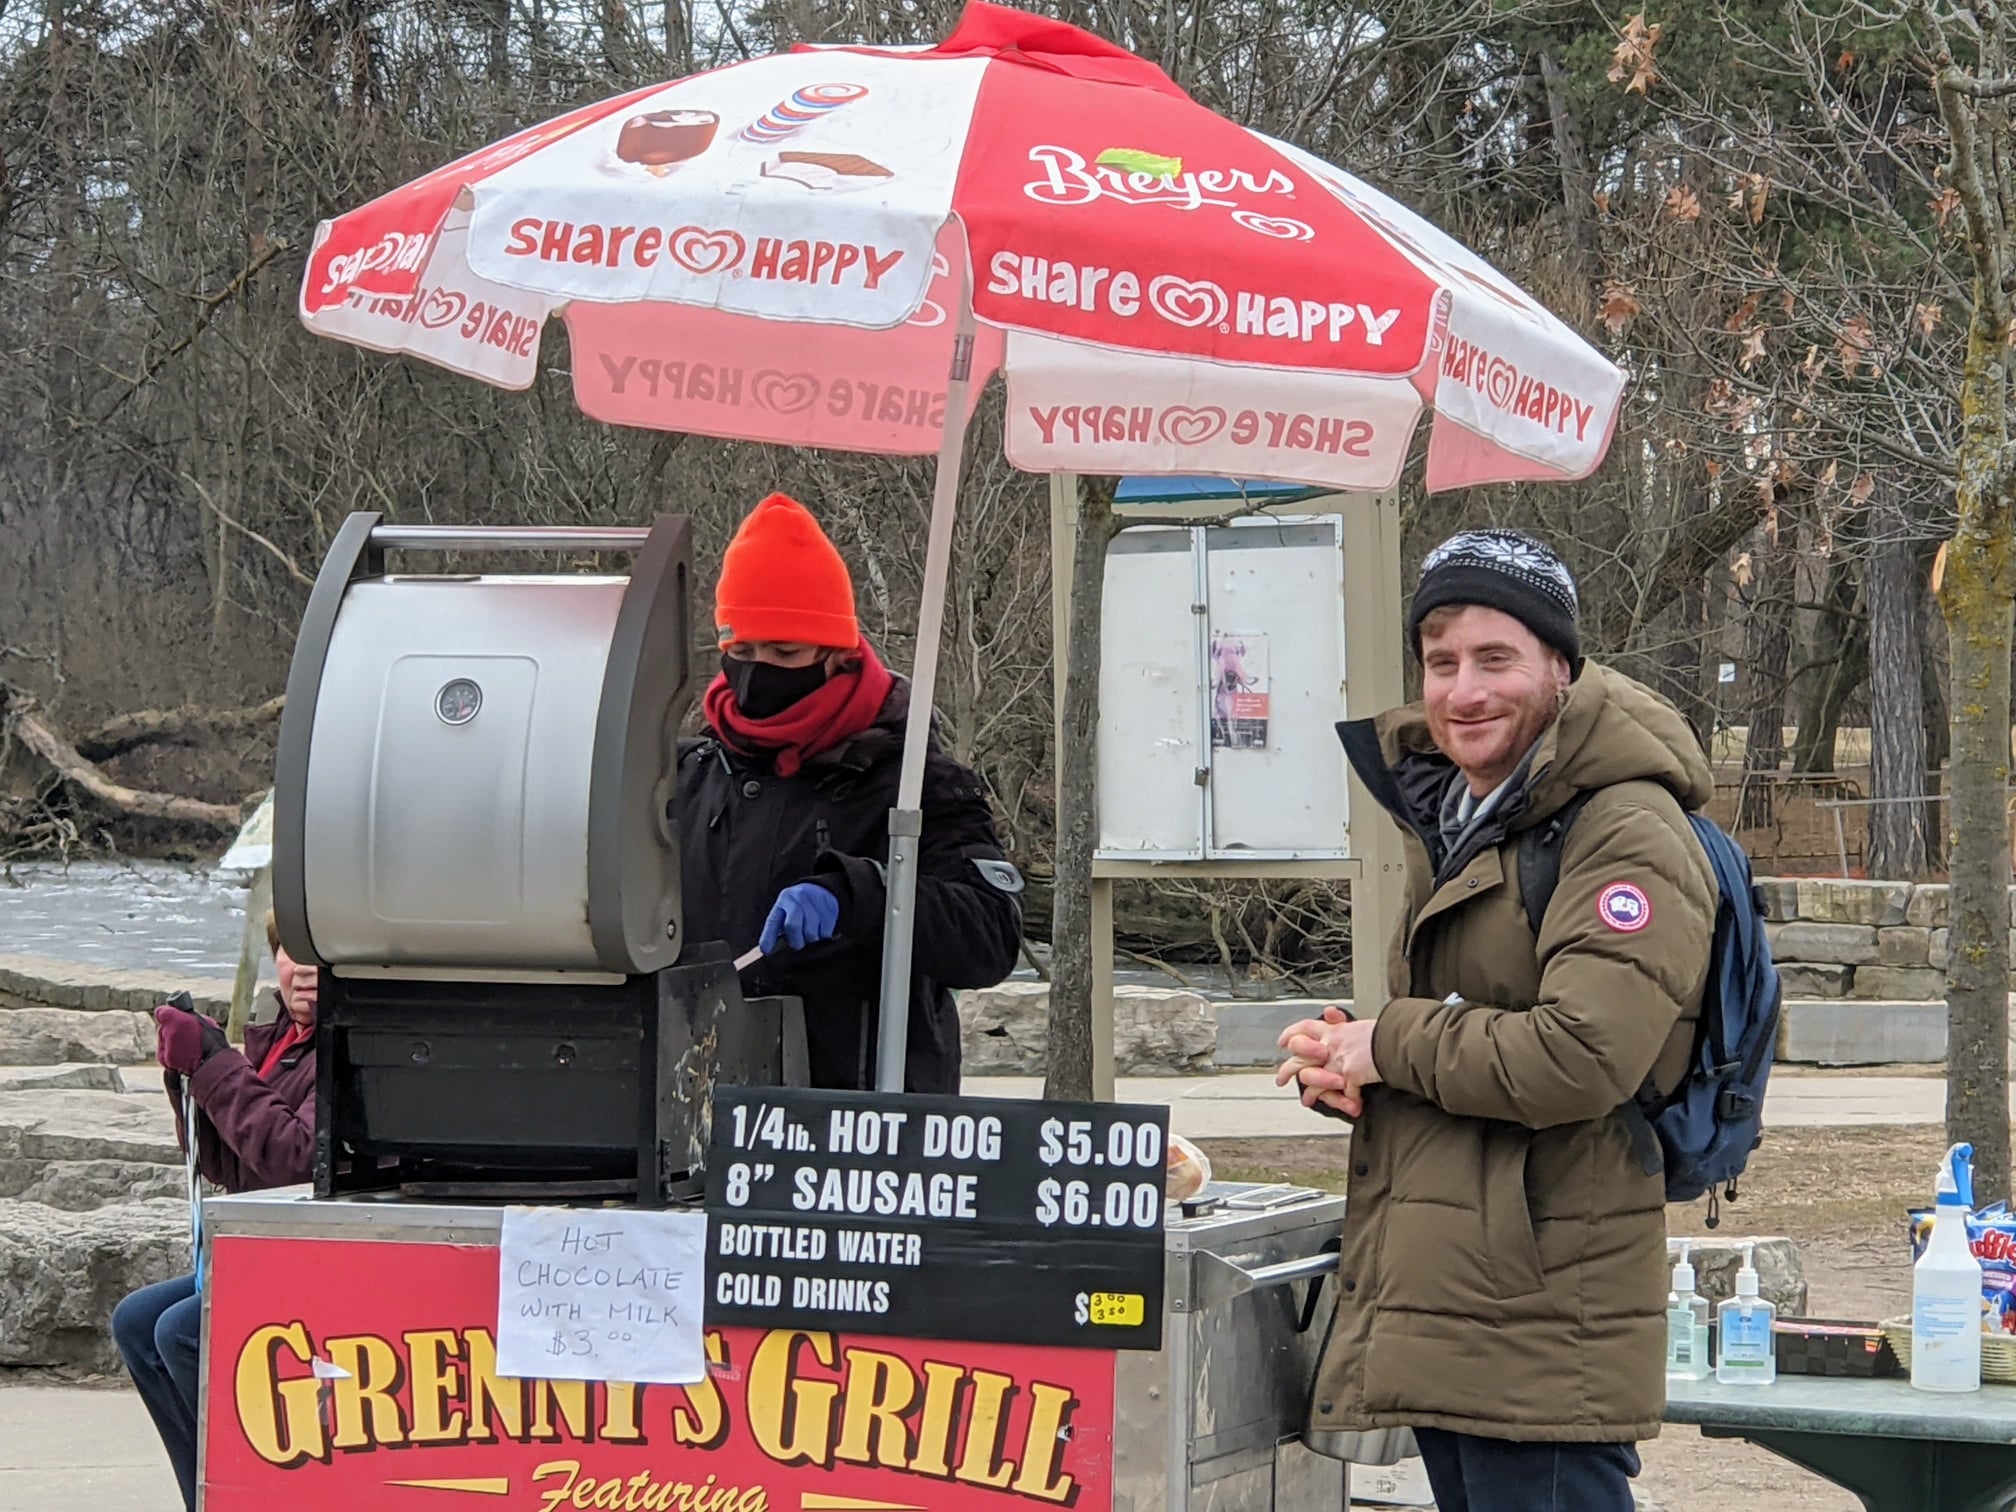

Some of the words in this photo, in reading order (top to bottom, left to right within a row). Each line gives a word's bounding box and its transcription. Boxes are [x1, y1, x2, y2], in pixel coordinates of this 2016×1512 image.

[1023, 144, 1295, 210] Breyers
[828, 1110, 907, 1156] HOT
[923, 1113, 1002, 1161] DOG
[1038, 1117, 1162, 1168] $5.00
[792, 1163, 978, 1219] SAUSAGE
[1035, 1177, 1159, 1228] $6.00
[561, 1227, 624, 1255] HOT
[719, 1224, 826, 1260] BOTTLED
[838, 1230, 921, 1266] WATER
[518, 1260, 684, 1290] CHOCOLATE
[716, 1272, 781, 1307] COLD
[792, 1276, 890, 1314] DRINKS
[521, 1298, 582, 1320] WITH
[609, 1302, 679, 1327] MILK
[747, 1328, 1081, 1507] GRILL
[532, 1460, 769, 1512] Featuring
